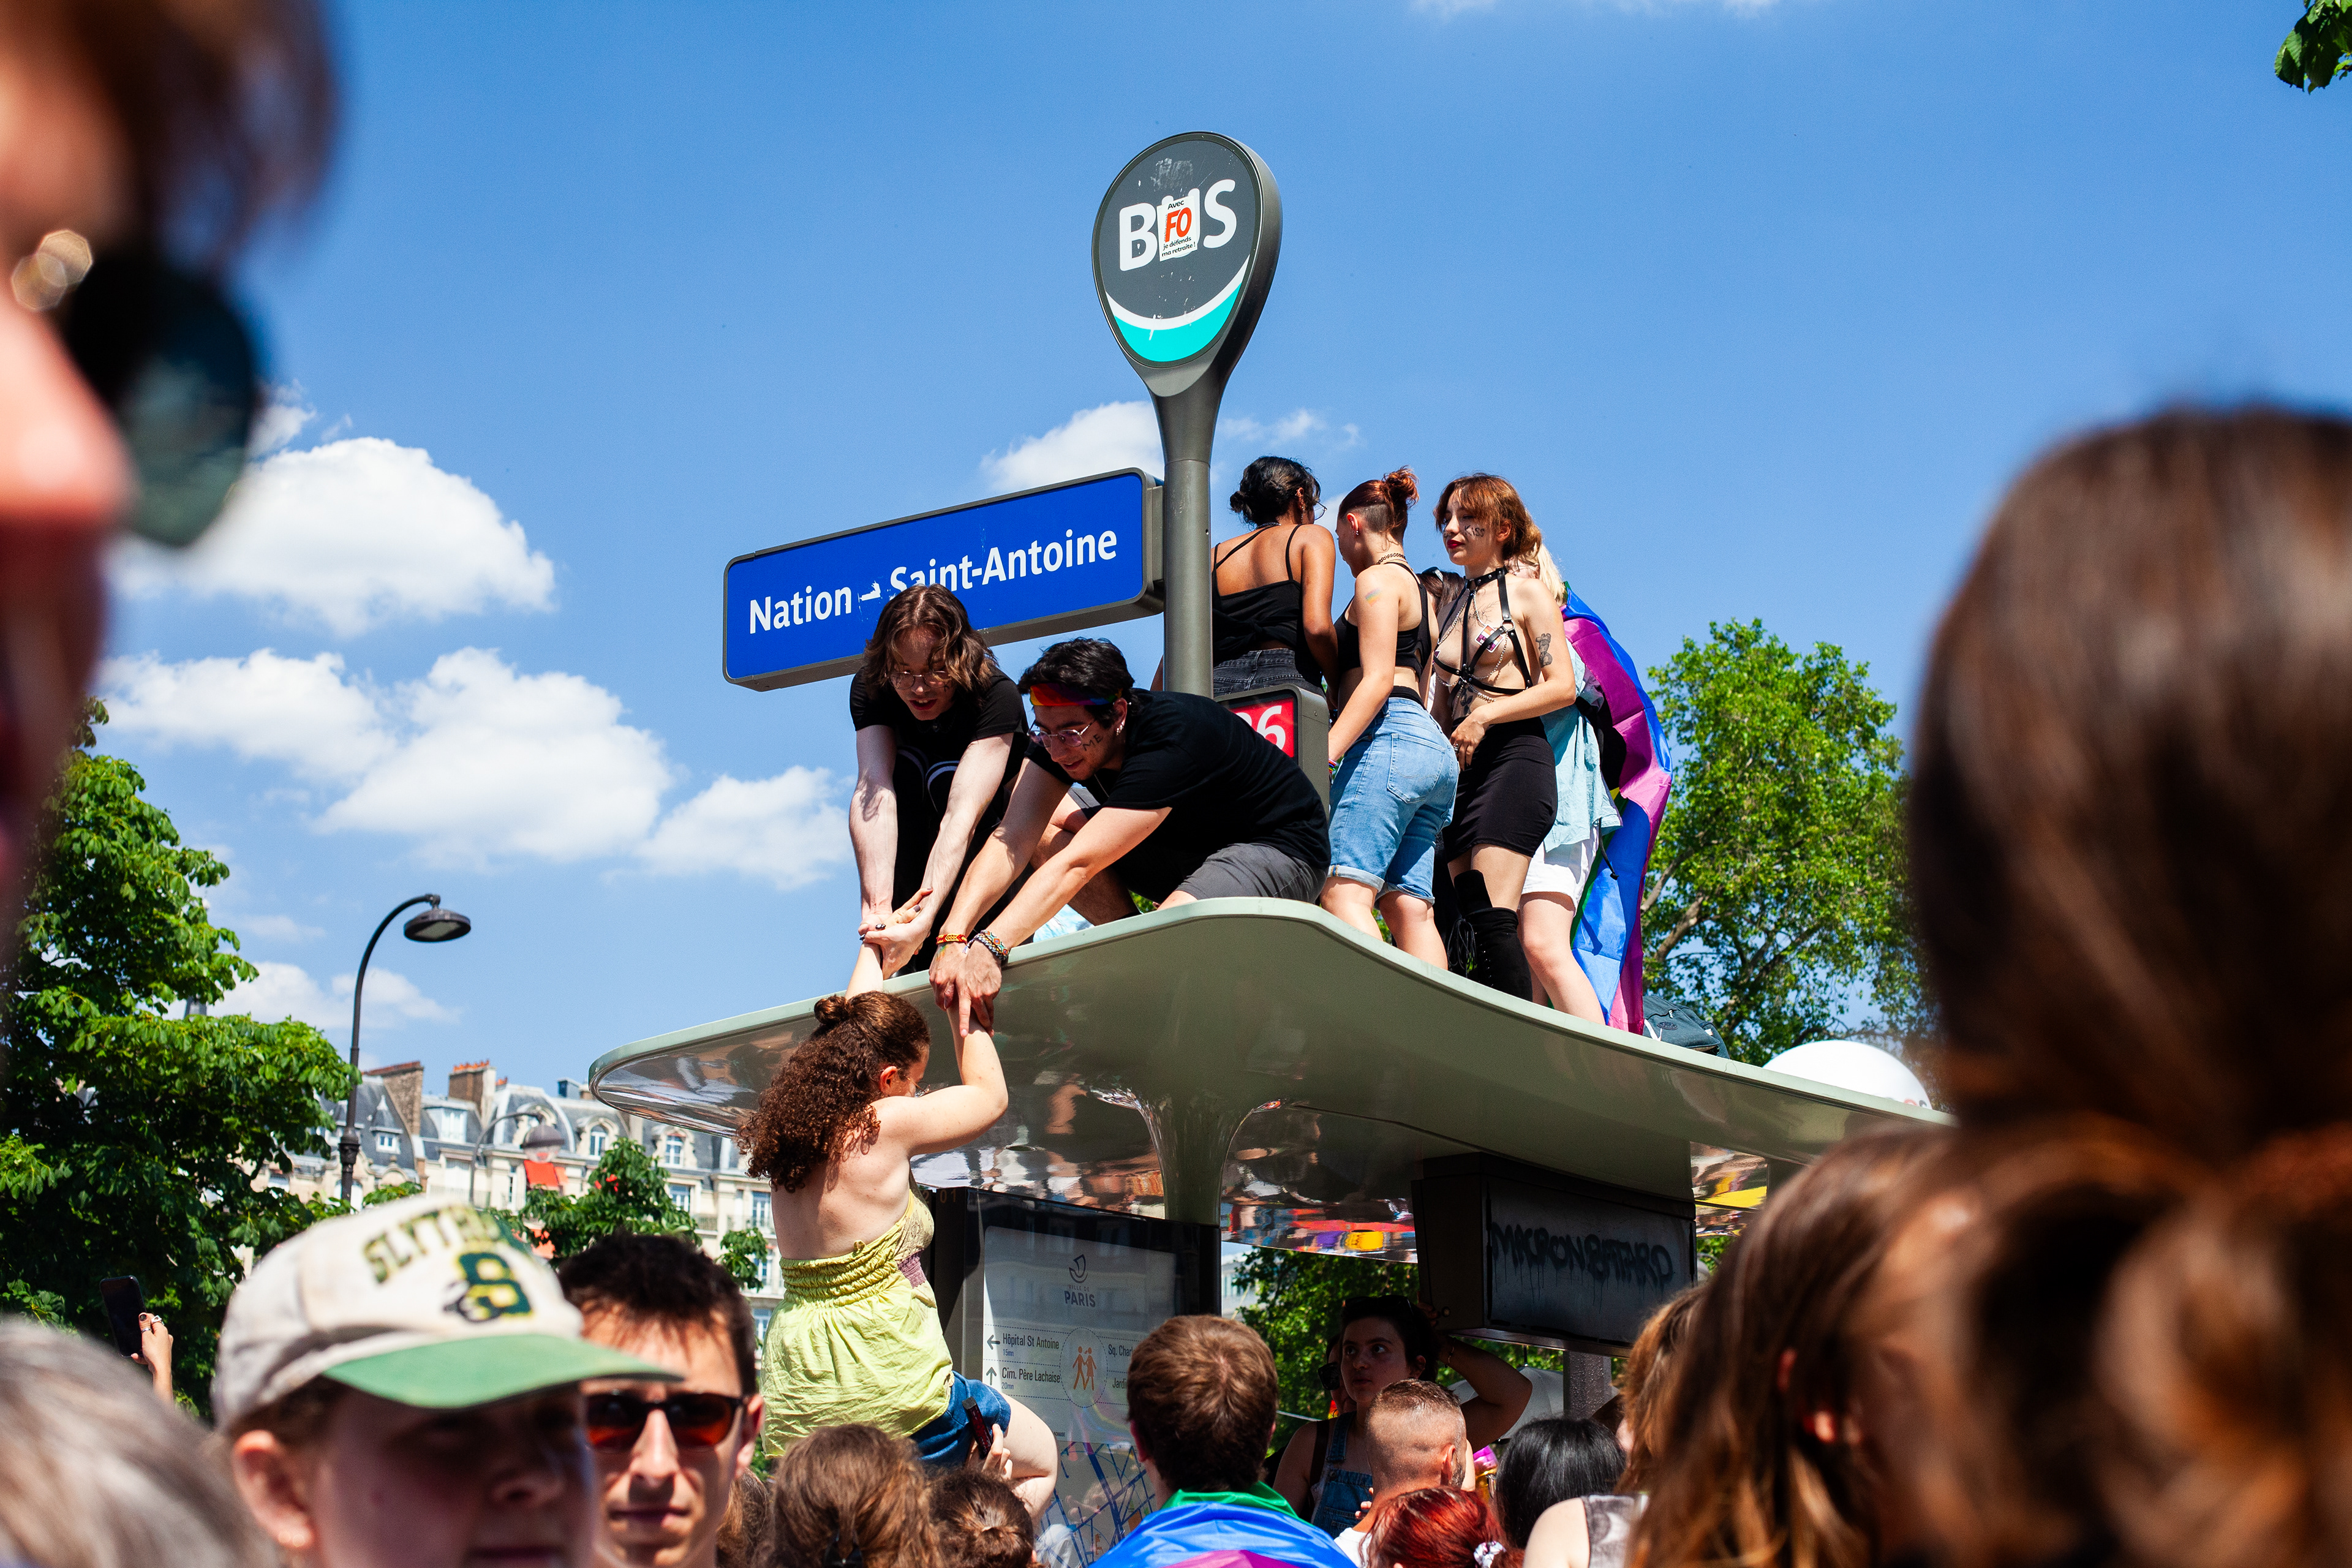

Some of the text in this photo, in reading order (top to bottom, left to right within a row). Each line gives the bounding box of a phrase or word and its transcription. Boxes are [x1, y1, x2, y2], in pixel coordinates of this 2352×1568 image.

[1167, 200, 1184, 209] Avec
[1165, 207, 1192, 243] FO
[1169, 236, 1191, 247] défends
[750, 585, 852, 635] Nation
[1082, 734, 1103, 752] ME
[1064, 1291, 1096, 1308] PARIS
[1003, 1333, 1060, 1350] Hôpital St Antoine
[1108, 1344, 1117, 1358] Sq.
[1002, 1367, 1060, 1384] Cim. Père Lachaise
[1112, 1378, 1128, 1389] Jardi
